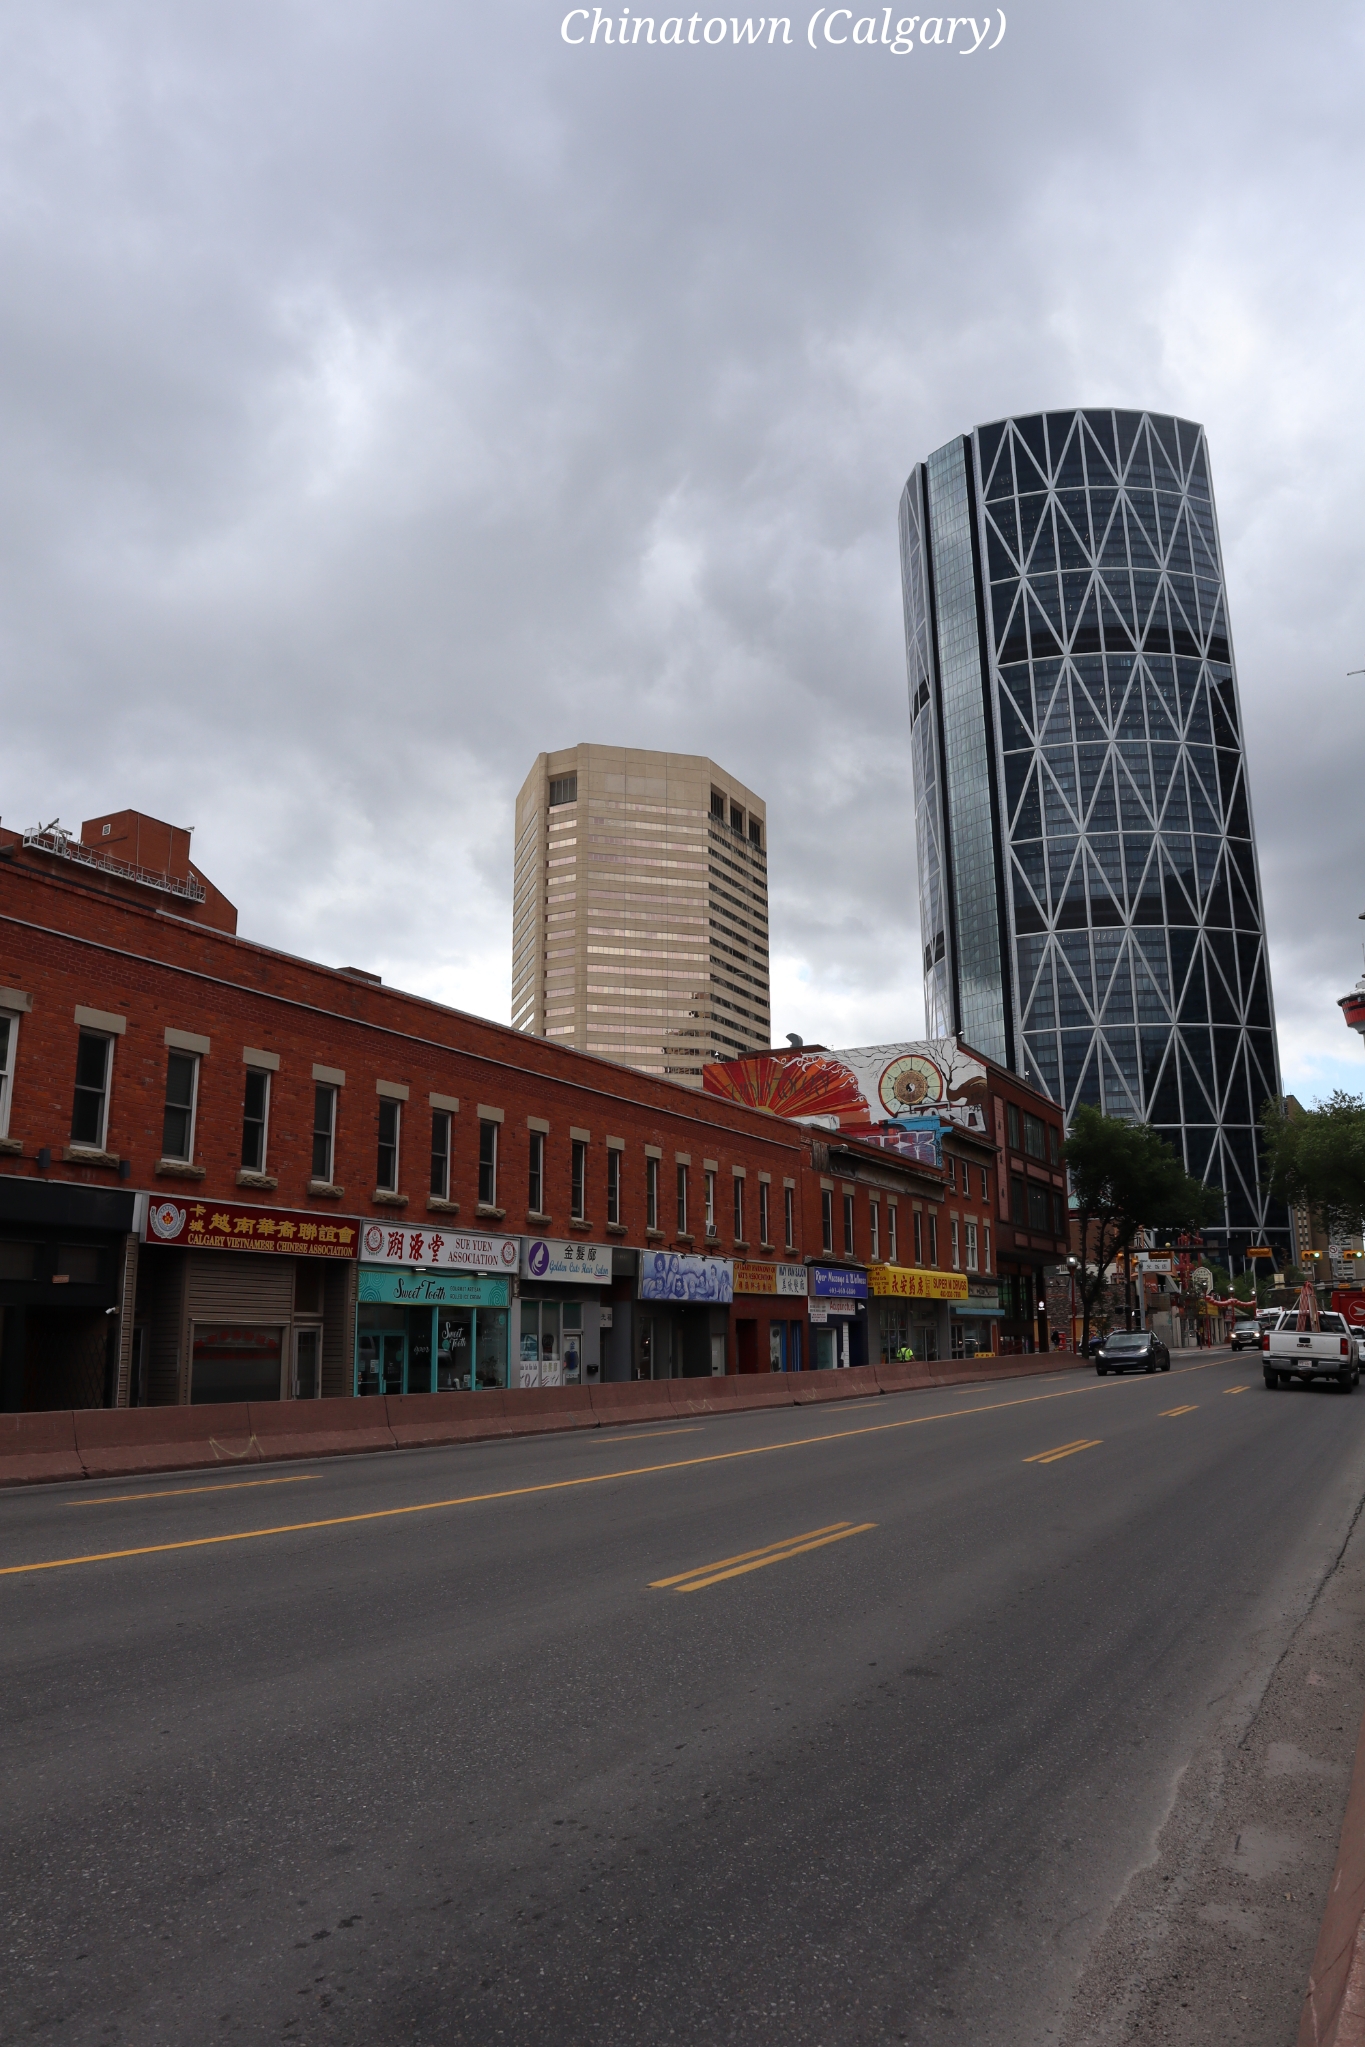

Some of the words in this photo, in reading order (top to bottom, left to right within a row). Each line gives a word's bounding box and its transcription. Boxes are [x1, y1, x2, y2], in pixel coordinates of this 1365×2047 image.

[187, 1233, 226, 1247] CALGARY
[226, 1236, 275, 1251] VIETNAMESE
[276, 1240, 308, 1254] CHINESE
[308, 1243, 354, 1257] ASSOCIATION
[455, 1237, 471, 1250] SUE
[472, 1239, 493, 1252] YUEN
[447, 1251, 499, 1266] ASSOCIATION
[549, 1259, 567, 1274] Golden
[581, 1262, 593, 1274] Hair
[594, 1264, 609, 1275] Salon
[828, 1271, 845, 1286] Massage
[933, 1277, 947, 1290] SUPER
[952, 1279, 967, 1291] DRUGS
[393, 1277, 423, 1299] Sweet
[421, 1279, 447, 1300] Tooth
[829, 1300, 855, 1312] Acupuncture
[441, 1321, 465, 1340] Sweet
[449, 1336, 467, 1352] Tooth
